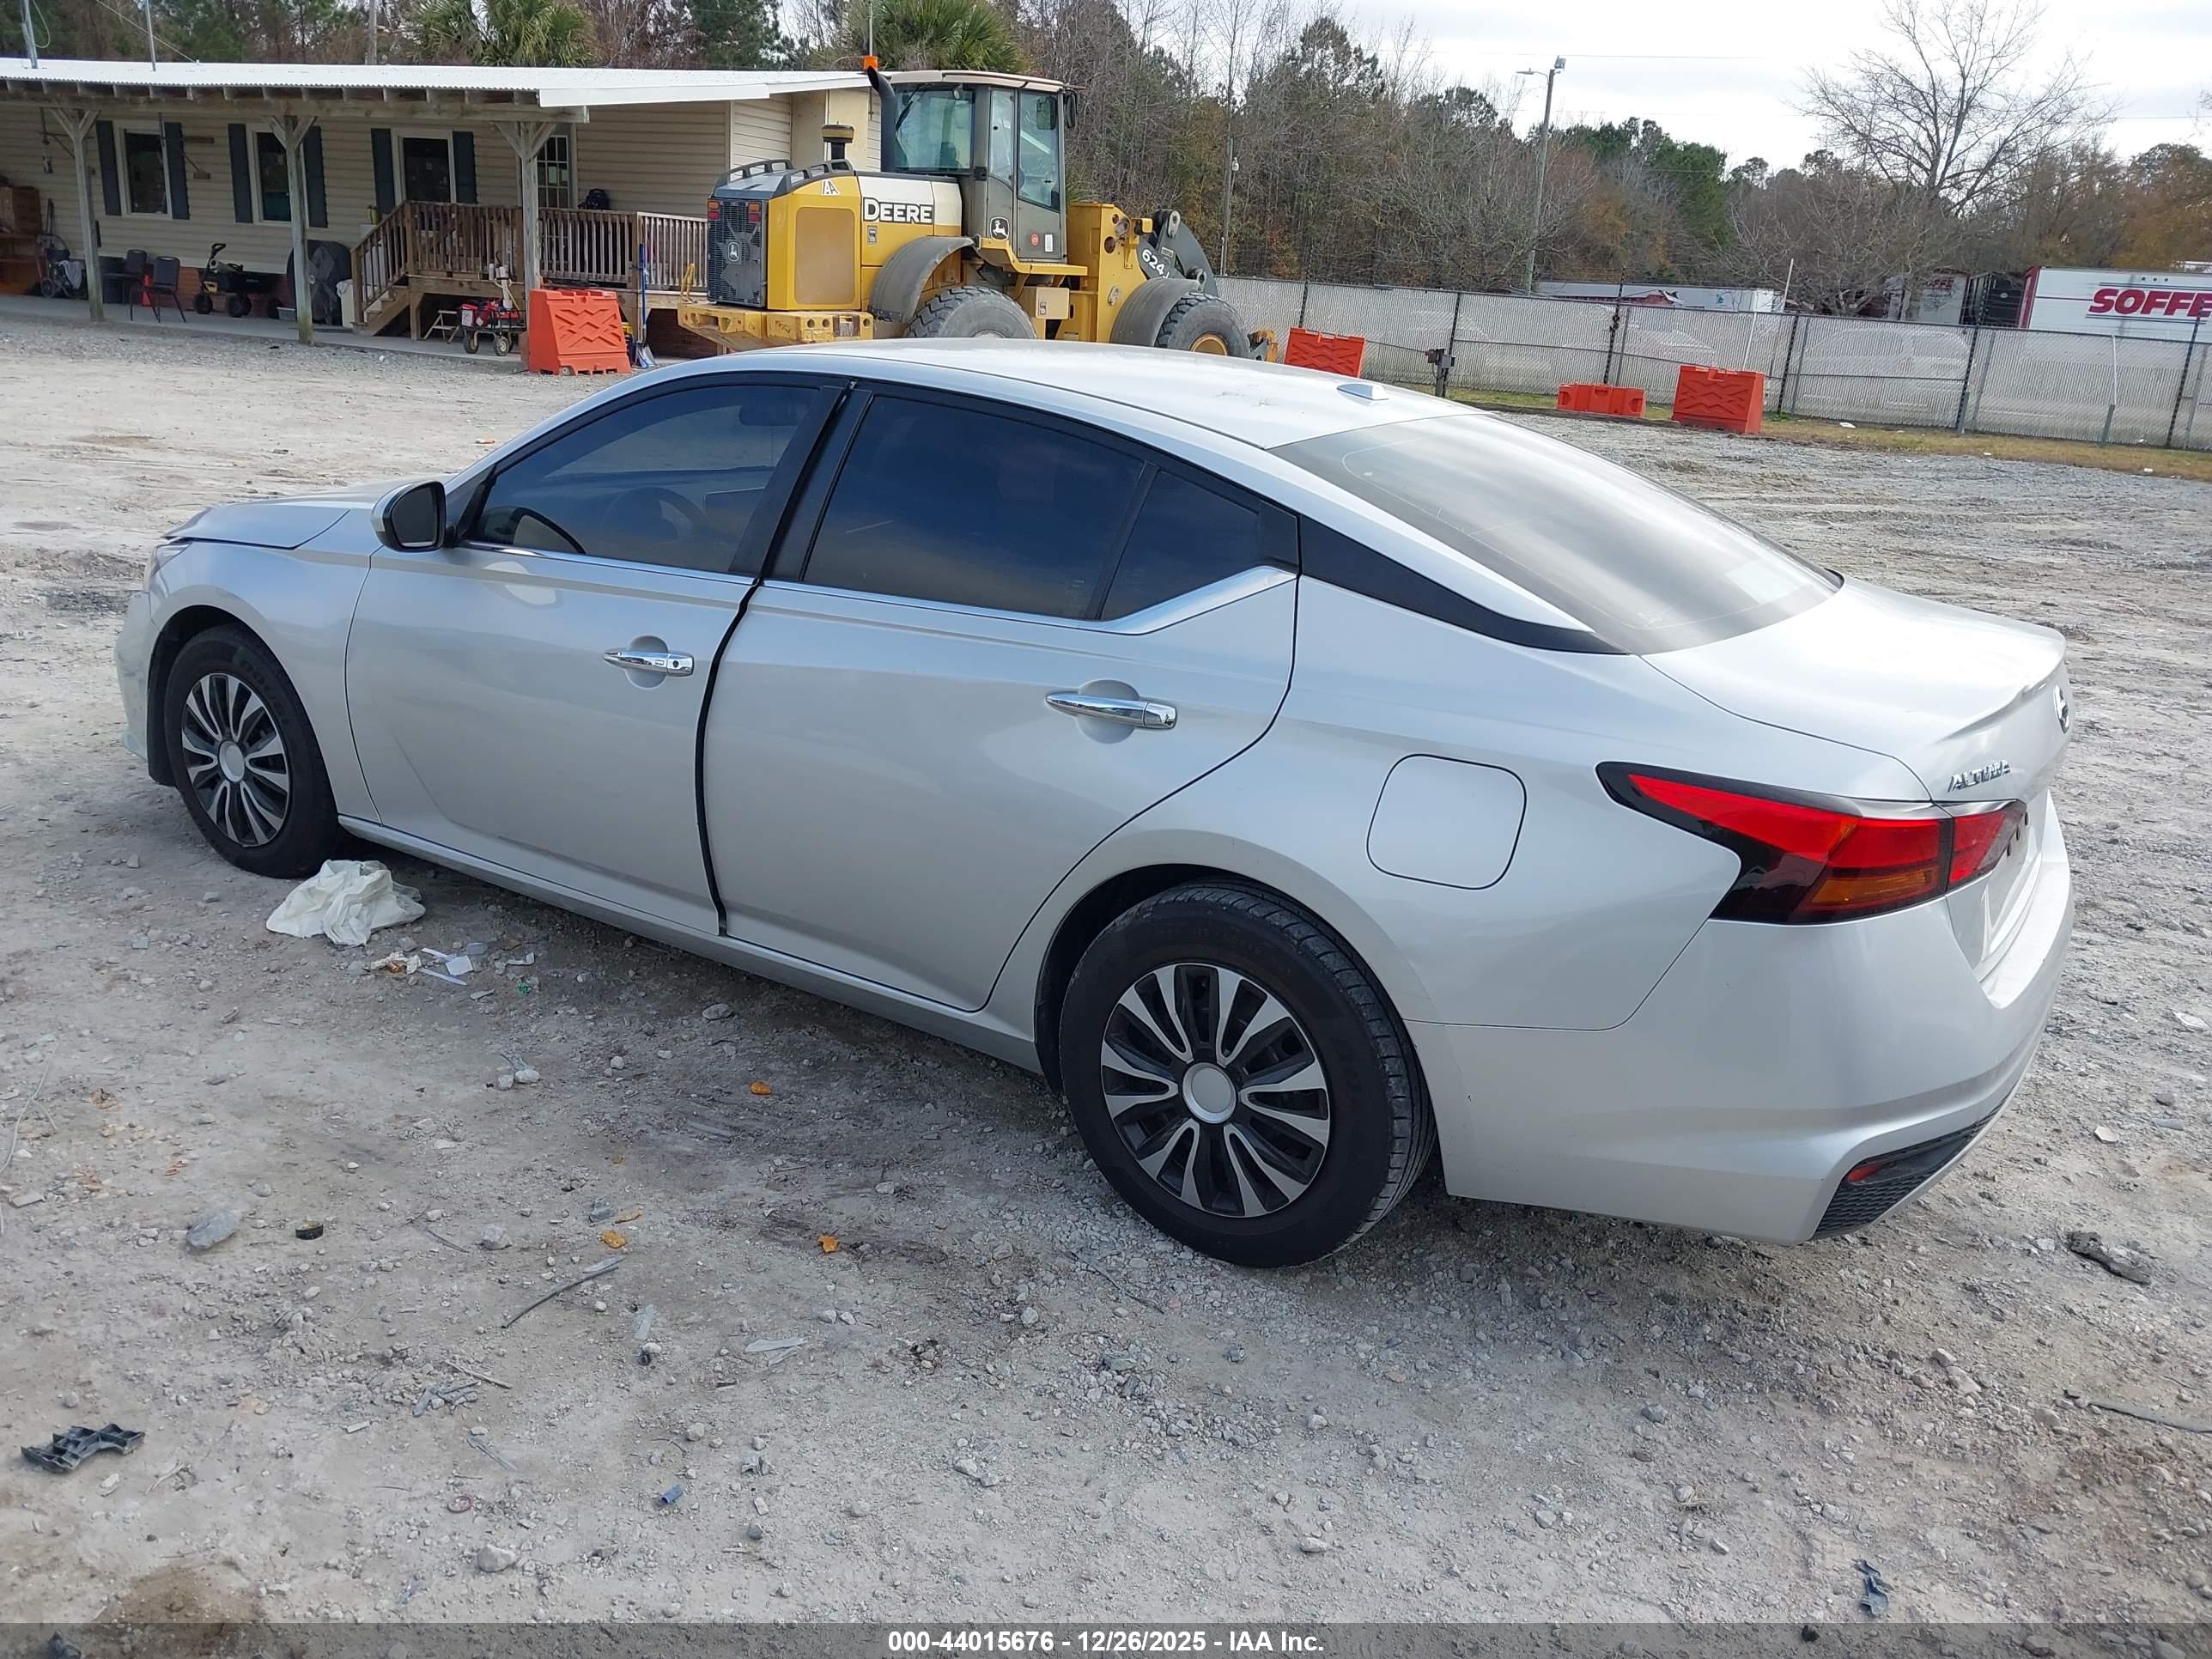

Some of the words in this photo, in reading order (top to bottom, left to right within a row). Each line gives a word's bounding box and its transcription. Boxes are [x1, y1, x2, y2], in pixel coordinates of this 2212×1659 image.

[864, 198, 933, 223] DEERE
[2088, 288, 2212, 318] SOFFE
[1947, 760, 2011, 792] ALTIMA
